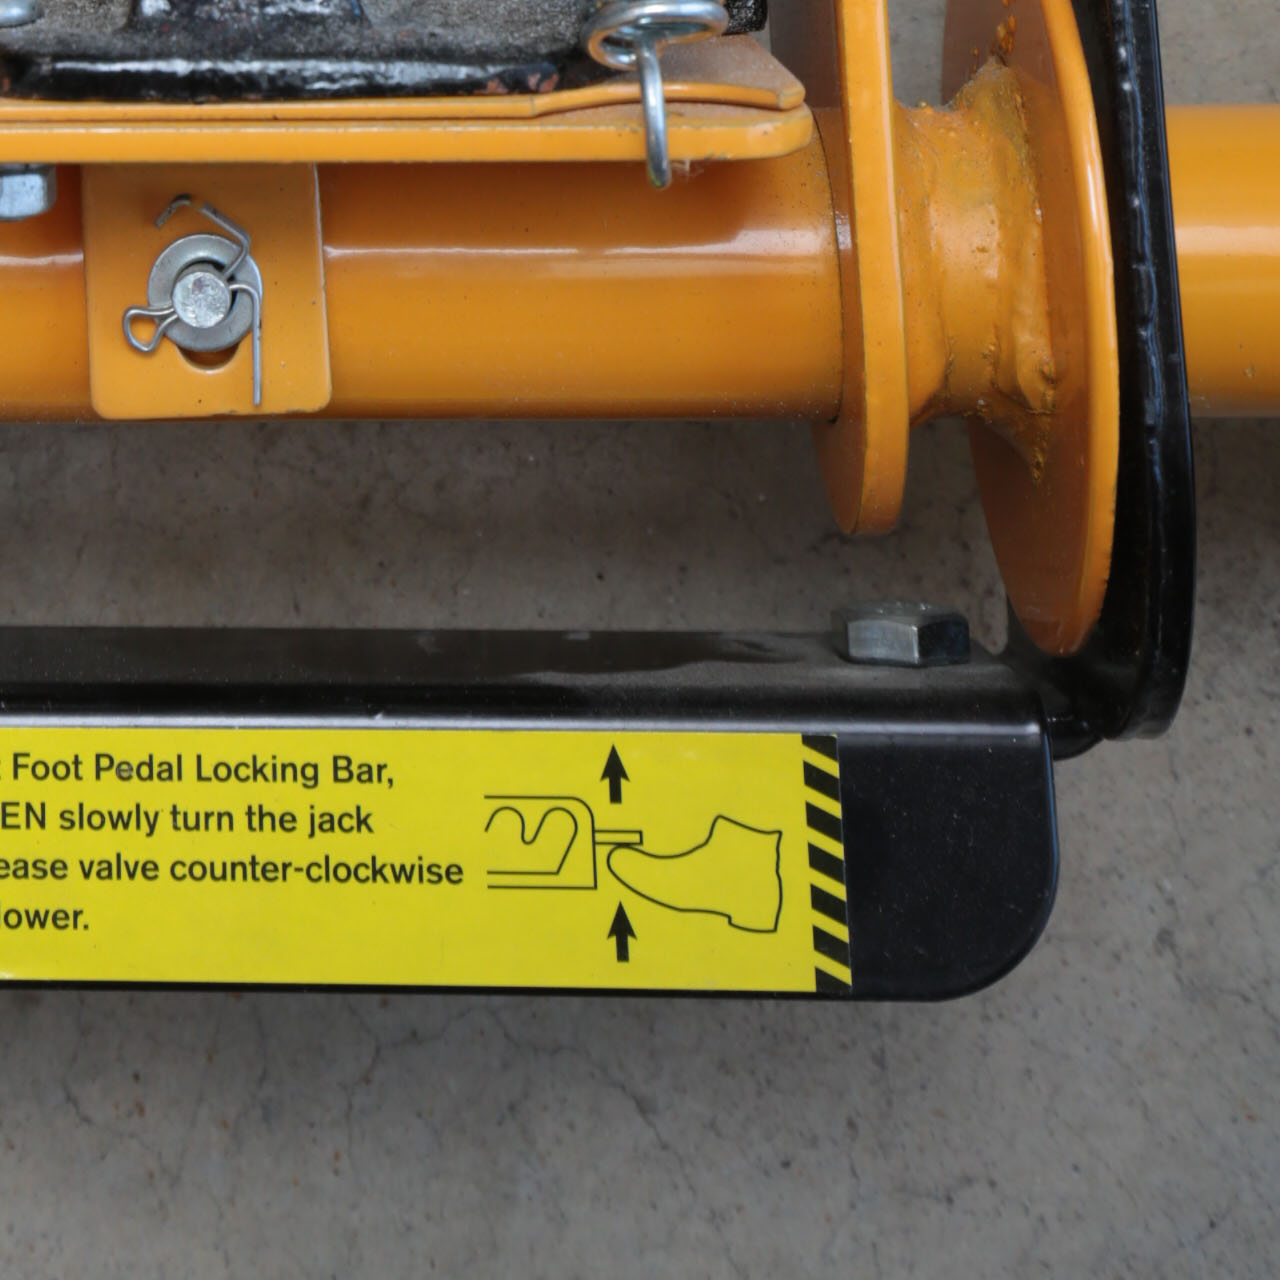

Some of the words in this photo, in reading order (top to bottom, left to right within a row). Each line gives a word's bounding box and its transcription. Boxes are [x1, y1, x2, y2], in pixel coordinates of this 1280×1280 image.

[12, 752, 83, 781] Foot
[95, 753, 183, 782] Pedal
[196, 754, 319, 789] Locking
[332, 755, 394, 788] Bar,
[59, 802, 159, 837] slowly
[170, 804, 234, 832] turn
[245, 804, 297, 833] the
[308, 805, 374, 839] jack
[79, 852, 159, 881] valve
[170, 855, 463, 885] counter-clockwise
